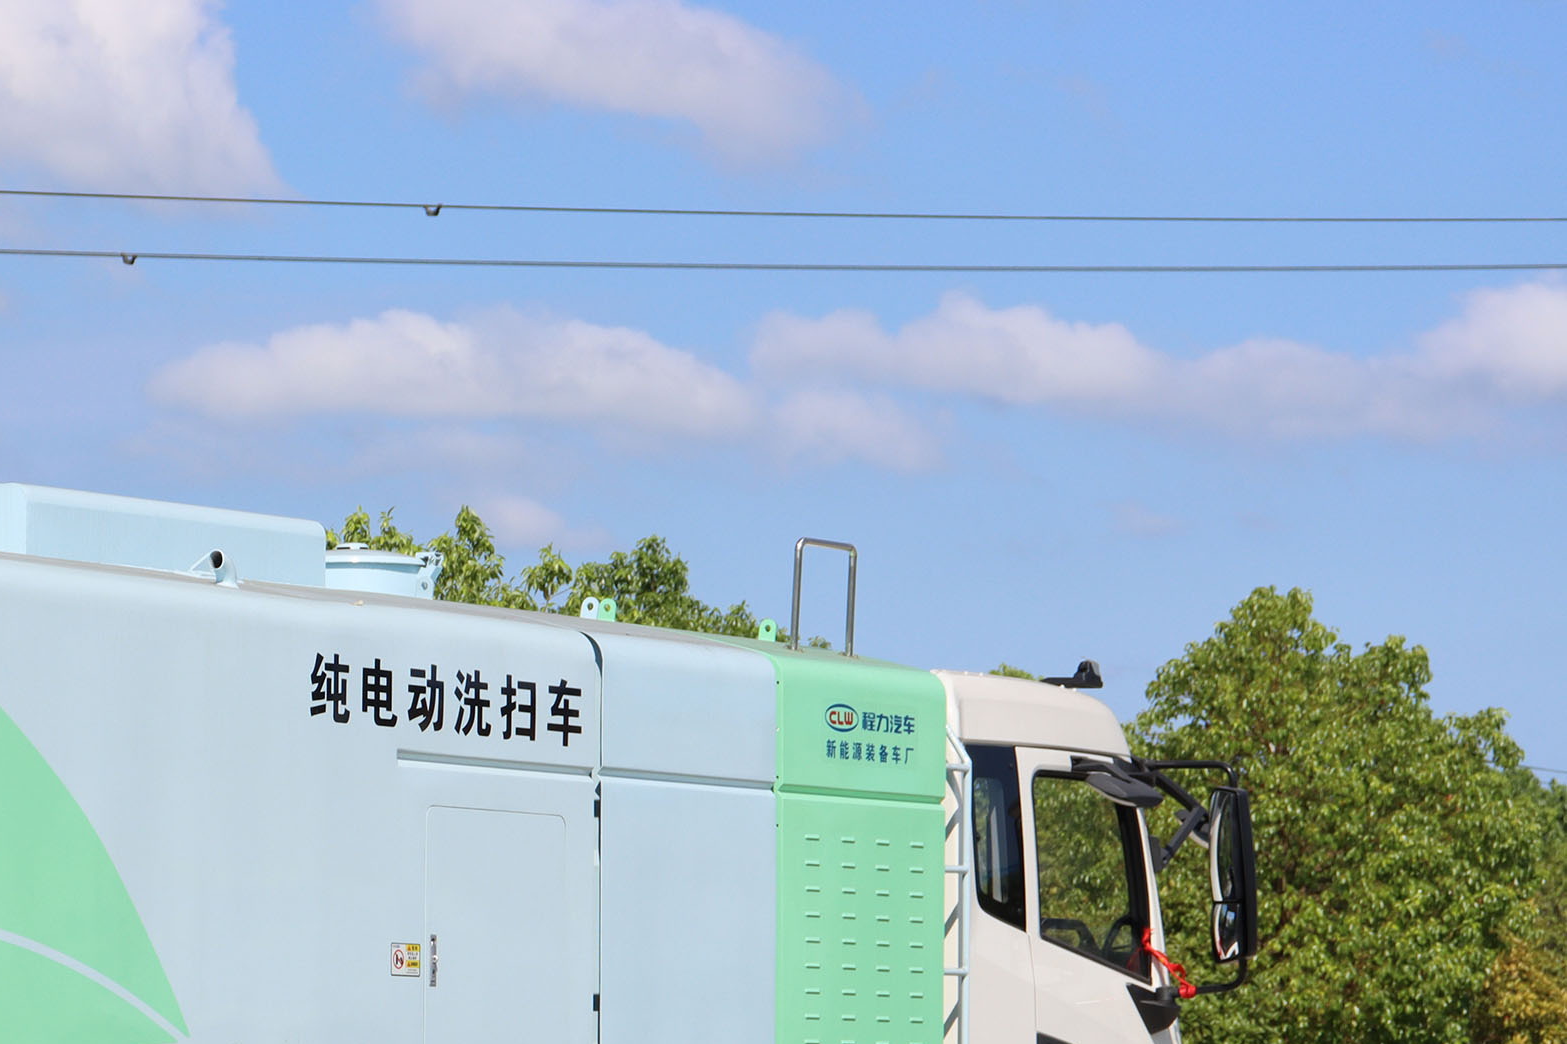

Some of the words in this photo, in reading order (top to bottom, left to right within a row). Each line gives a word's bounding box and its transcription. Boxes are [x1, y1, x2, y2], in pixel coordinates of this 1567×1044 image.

[309, 653, 583, 747] 纯电动洗扫车
[829, 710, 854, 726] CLW
[861, 711, 916, 735] 程力汽车
[825, 739, 915, 765] 新能源装备车厂
